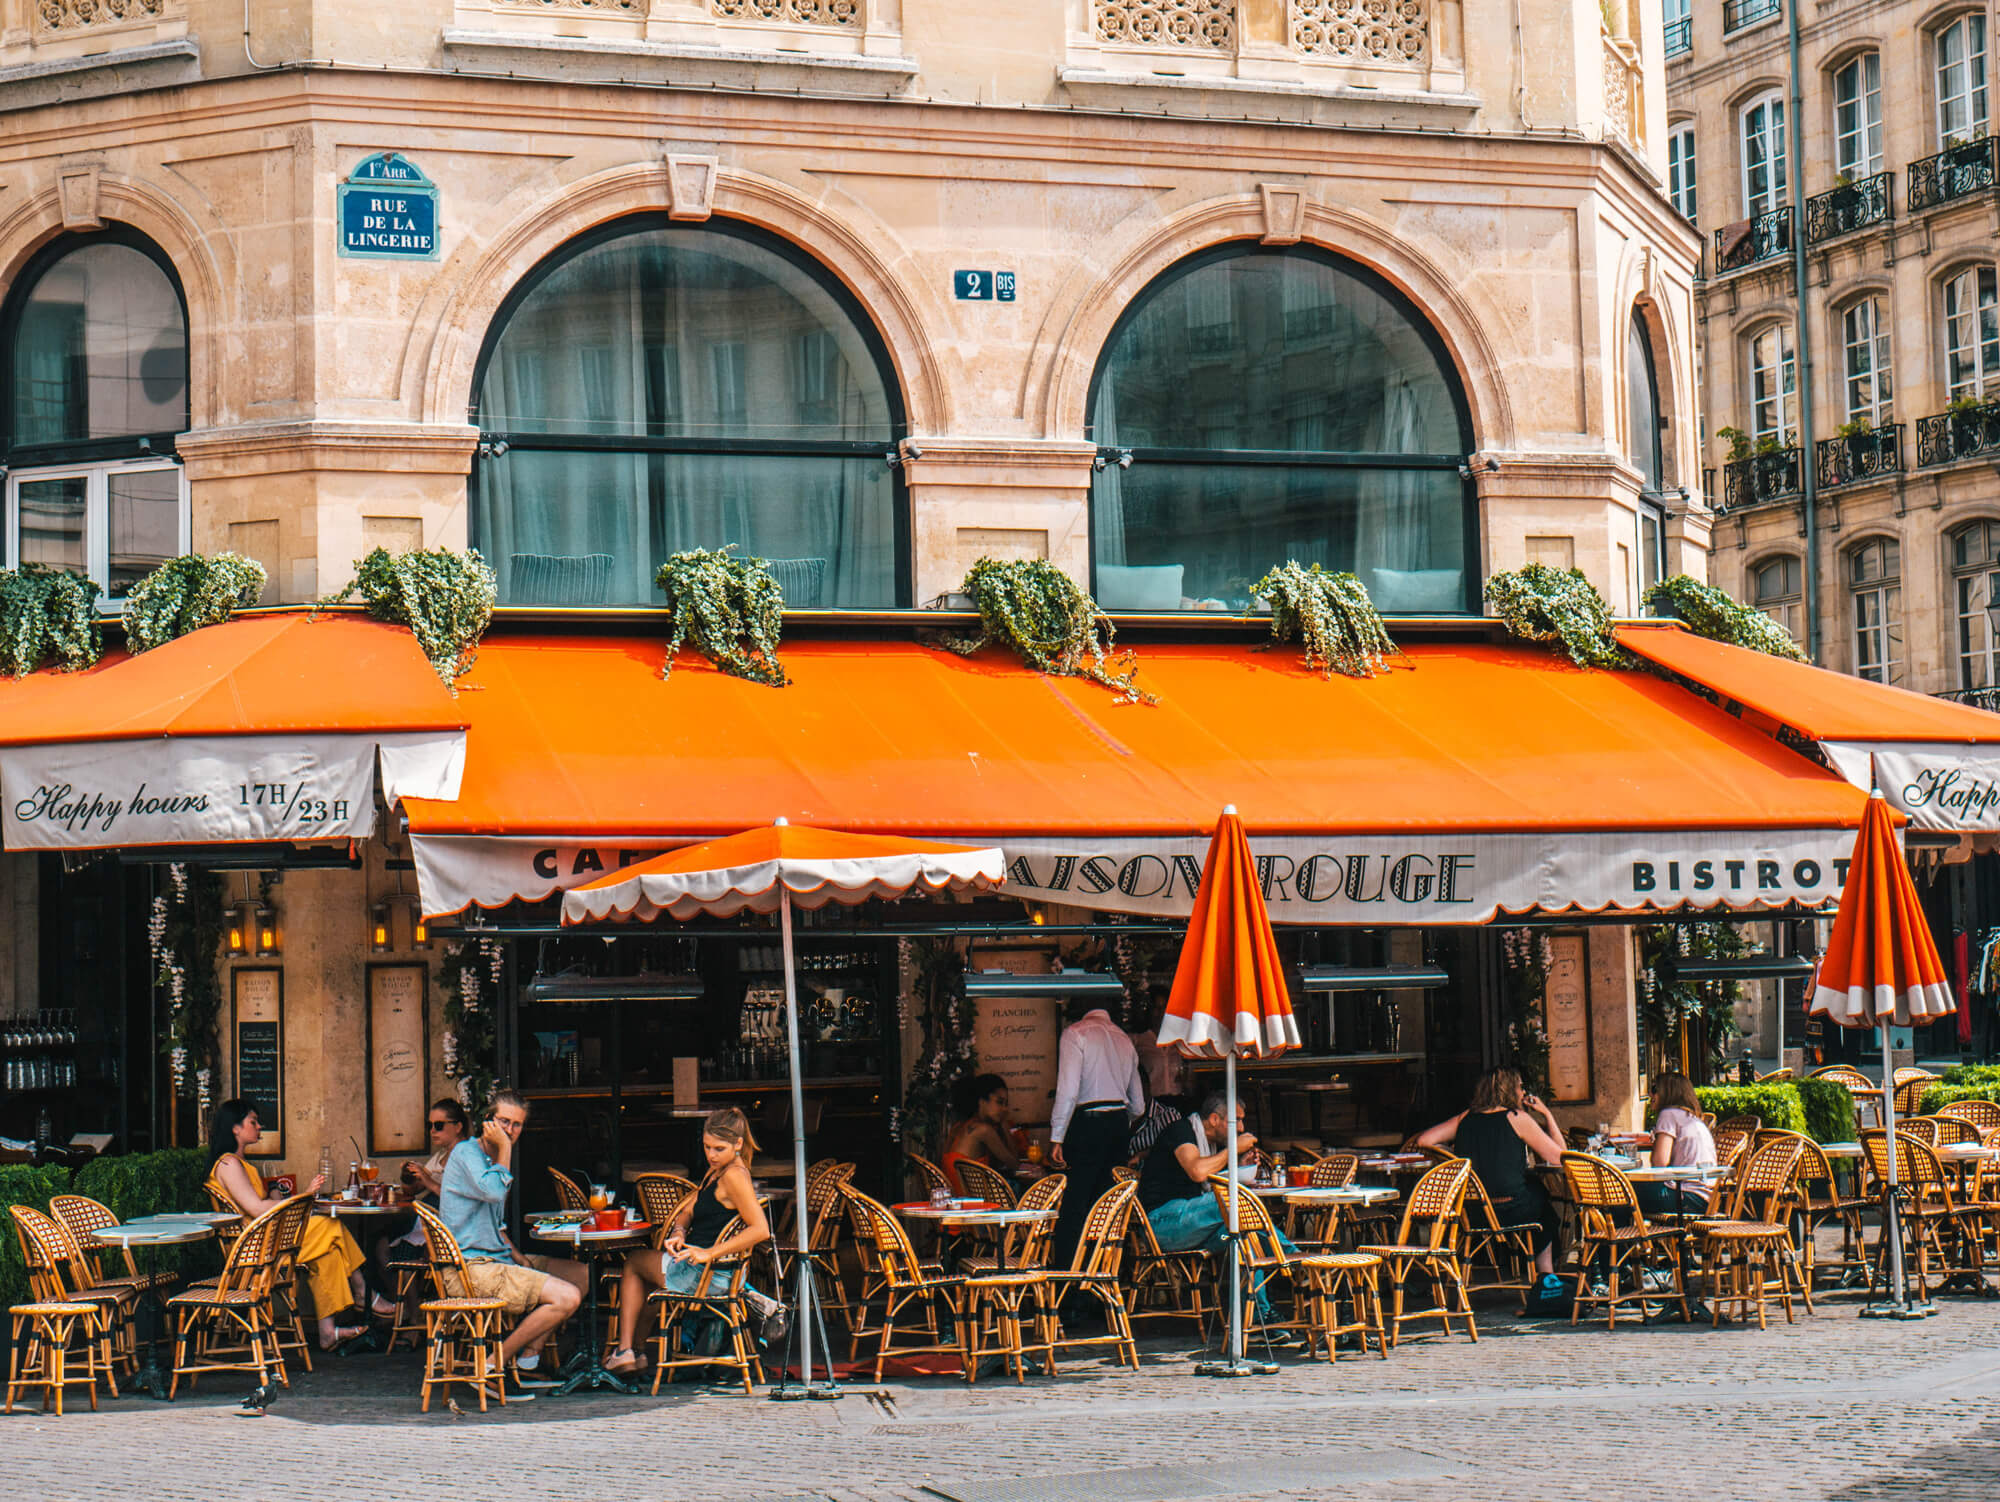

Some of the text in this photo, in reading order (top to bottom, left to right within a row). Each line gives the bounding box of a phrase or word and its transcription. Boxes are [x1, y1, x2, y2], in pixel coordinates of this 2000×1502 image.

[371, 199, 408, 213] RUE
[363, 216, 416, 231] DE LA
[348, 232, 431, 249] LINGERIE
[967, 272, 1014, 297] 2 BIS
[15, 783, 210, 831] Happy hours
[1902, 768, 2000, 823] Happ
[1007, 854, 1476, 903] AISON ROUGE
[1632, 858, 1852, 892] BISTROT
